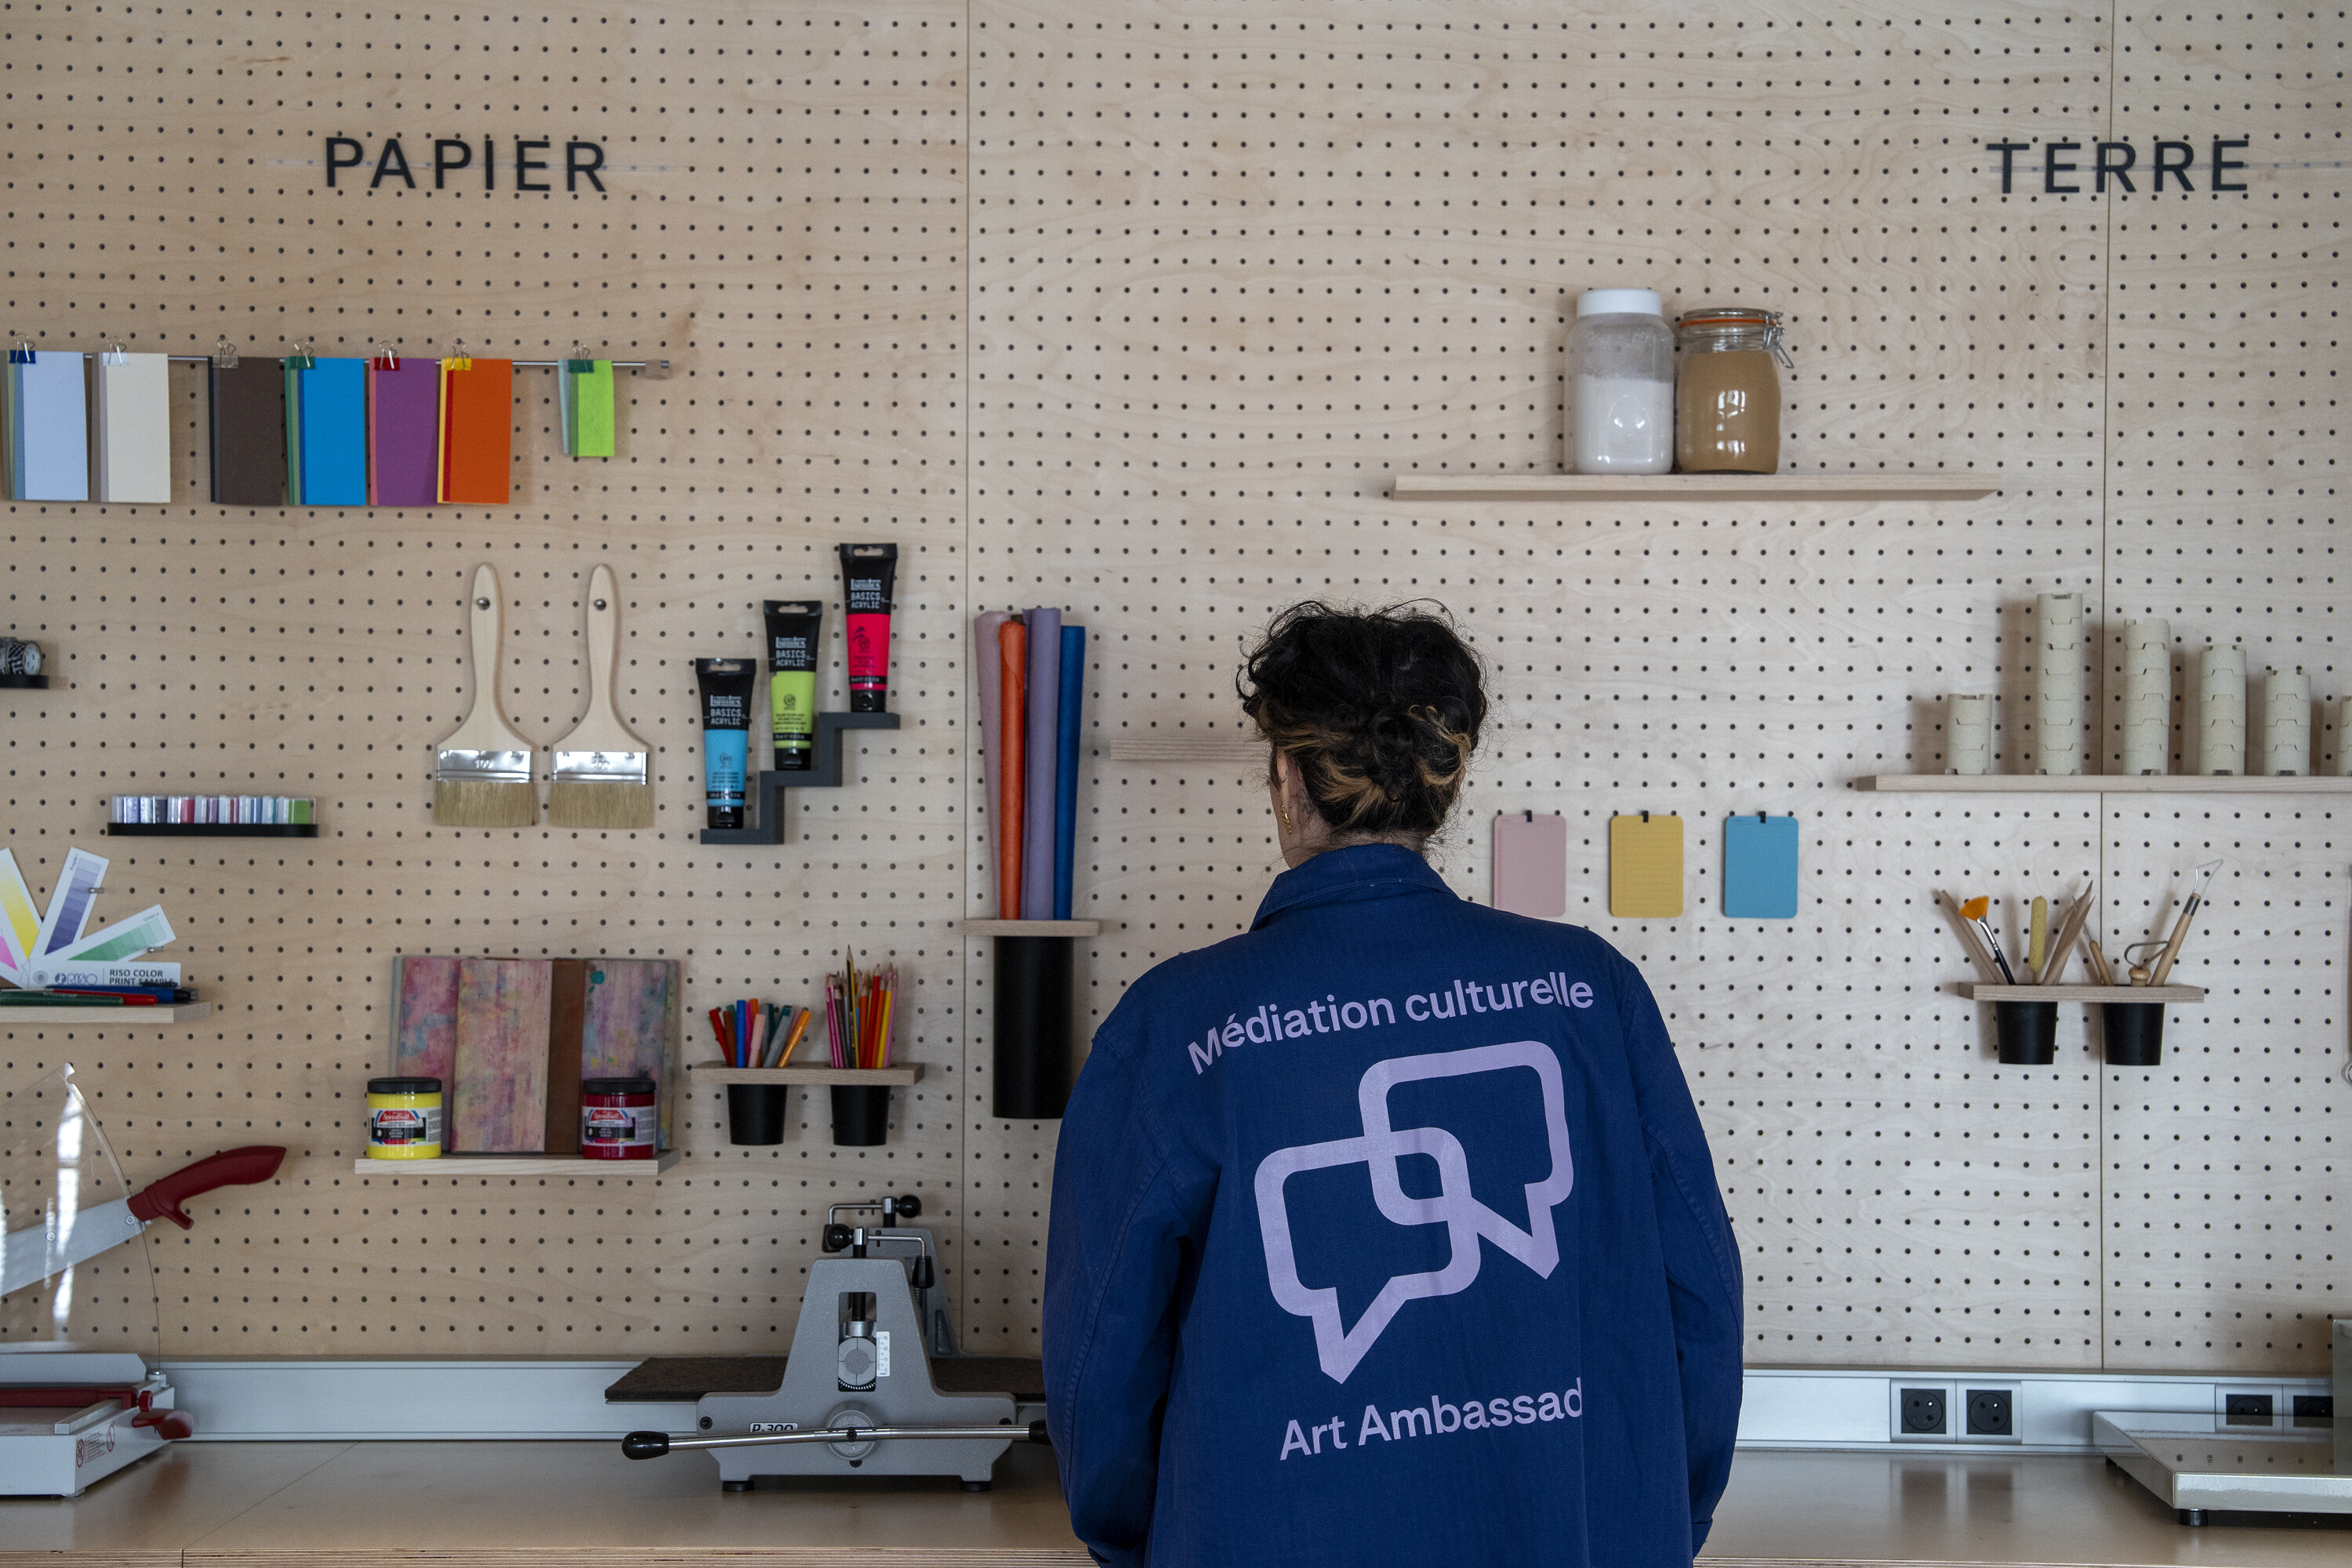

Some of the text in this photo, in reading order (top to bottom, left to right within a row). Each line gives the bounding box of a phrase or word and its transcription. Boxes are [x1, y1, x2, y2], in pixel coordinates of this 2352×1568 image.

[325, 136, 607, 192] PAPIER
[1986, 140, 2249, 194] TERRE
[850, 591, 881, 601] BASICS
[775, 649, 806, 659] BASICS
[710, 708, 742, 717] BASICS
[110, 968, 163, 978] RISO COLOR
[67, 973, 98, 985] RISO
[109, 977, 136, 985] PRINT
[1188, 971, 1595, 1075] Médiation culturelle
[1280, 1377, 1582, 1461] Art Ambassad
